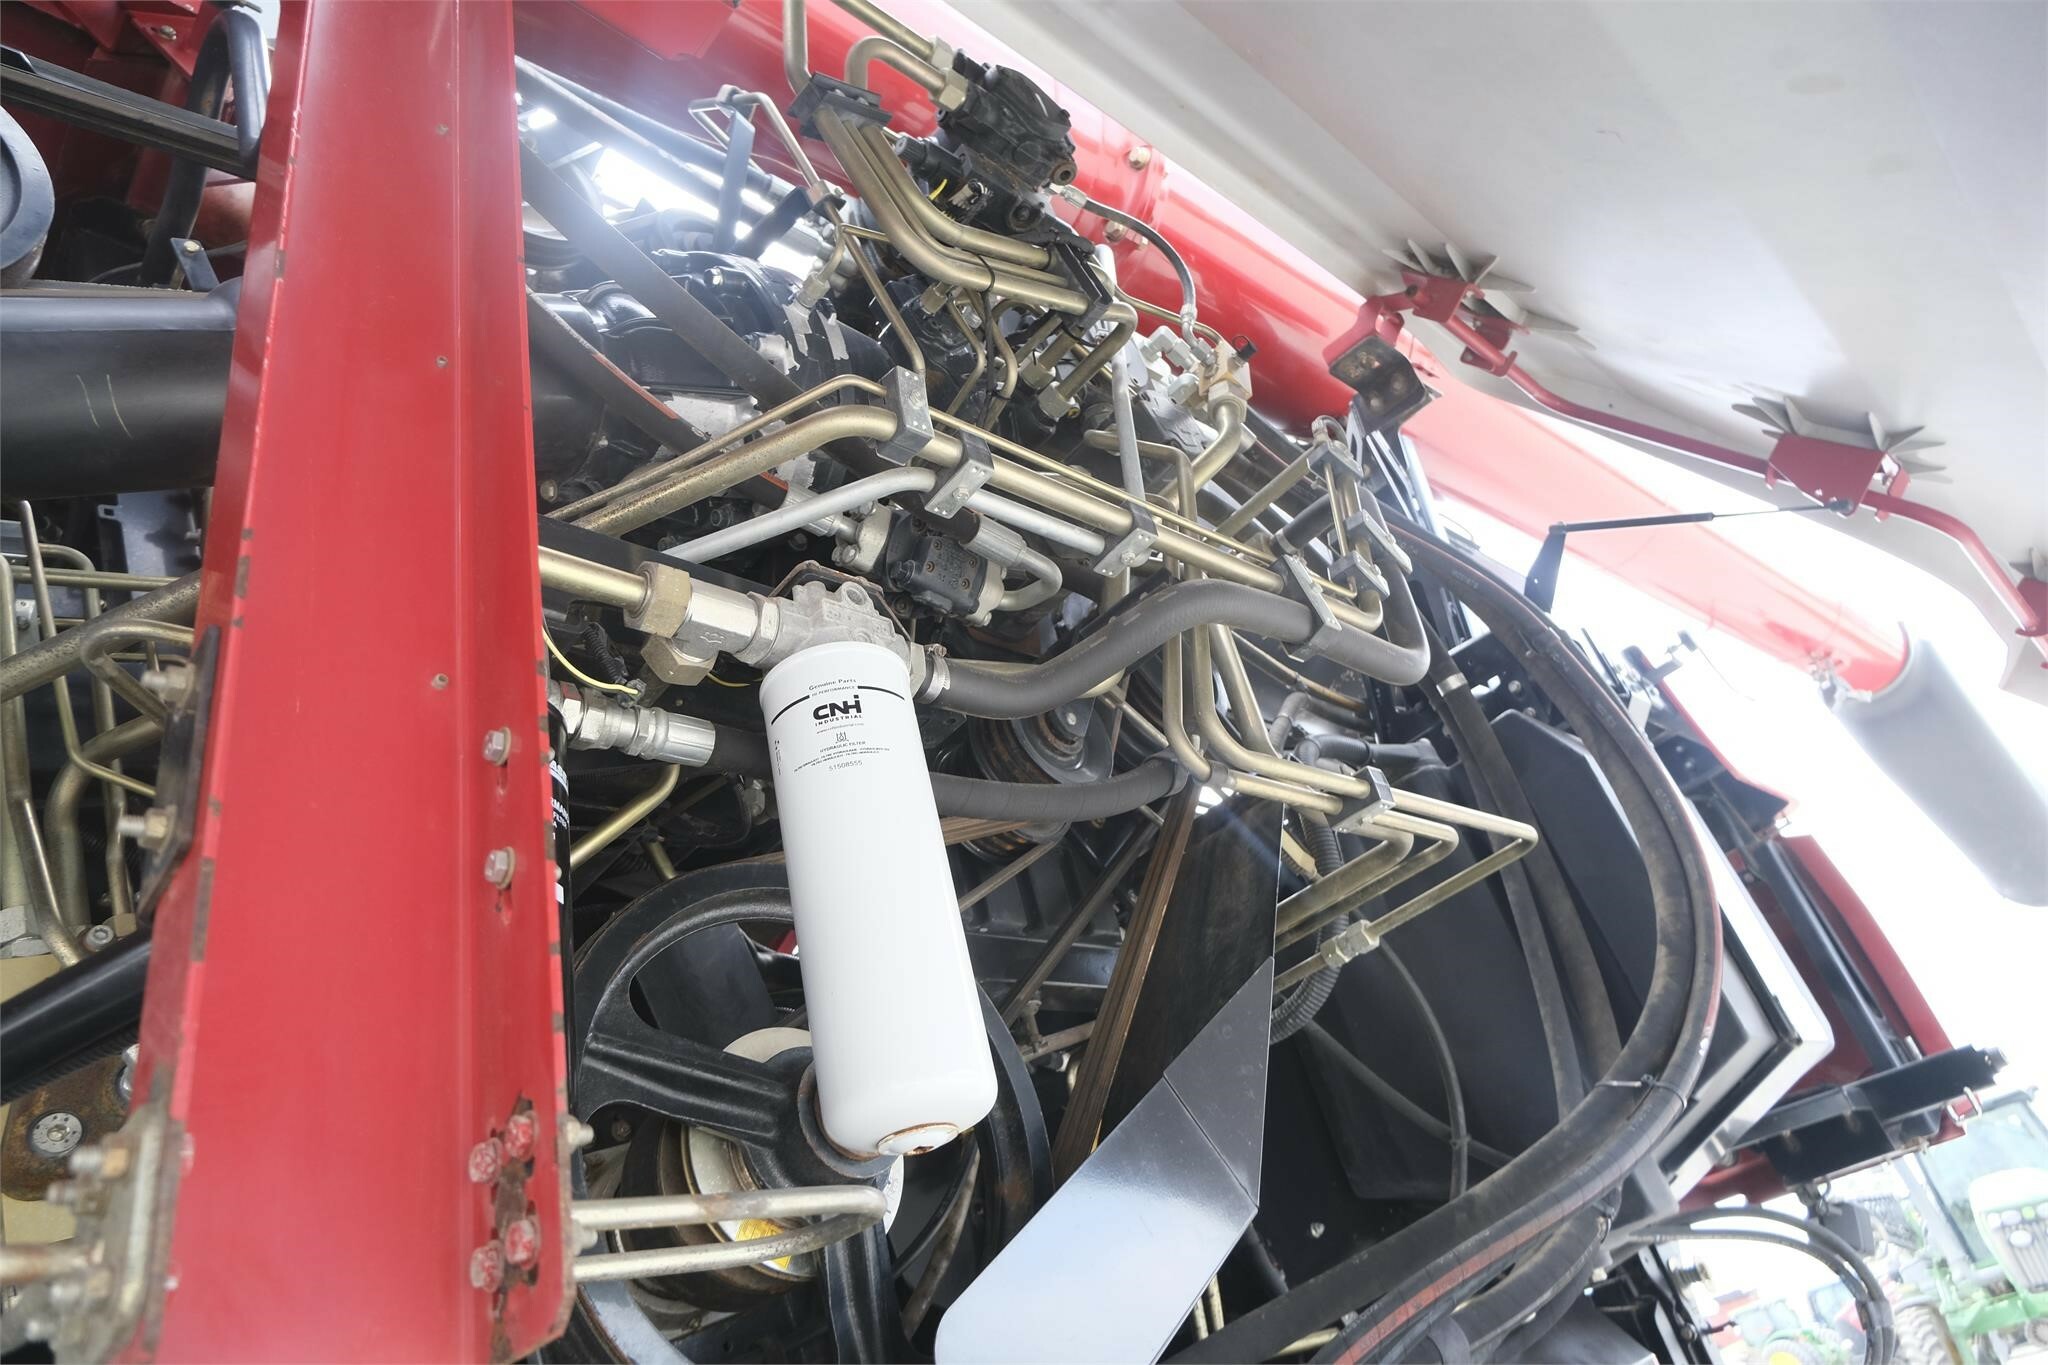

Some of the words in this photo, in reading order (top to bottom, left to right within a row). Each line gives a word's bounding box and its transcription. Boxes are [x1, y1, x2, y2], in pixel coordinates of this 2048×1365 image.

[809, 681, 836, 690] Genuine
[815, 714, 863, 727] INDUSTRIAL
[820, 742, 849, 753] HYDRAULIC
